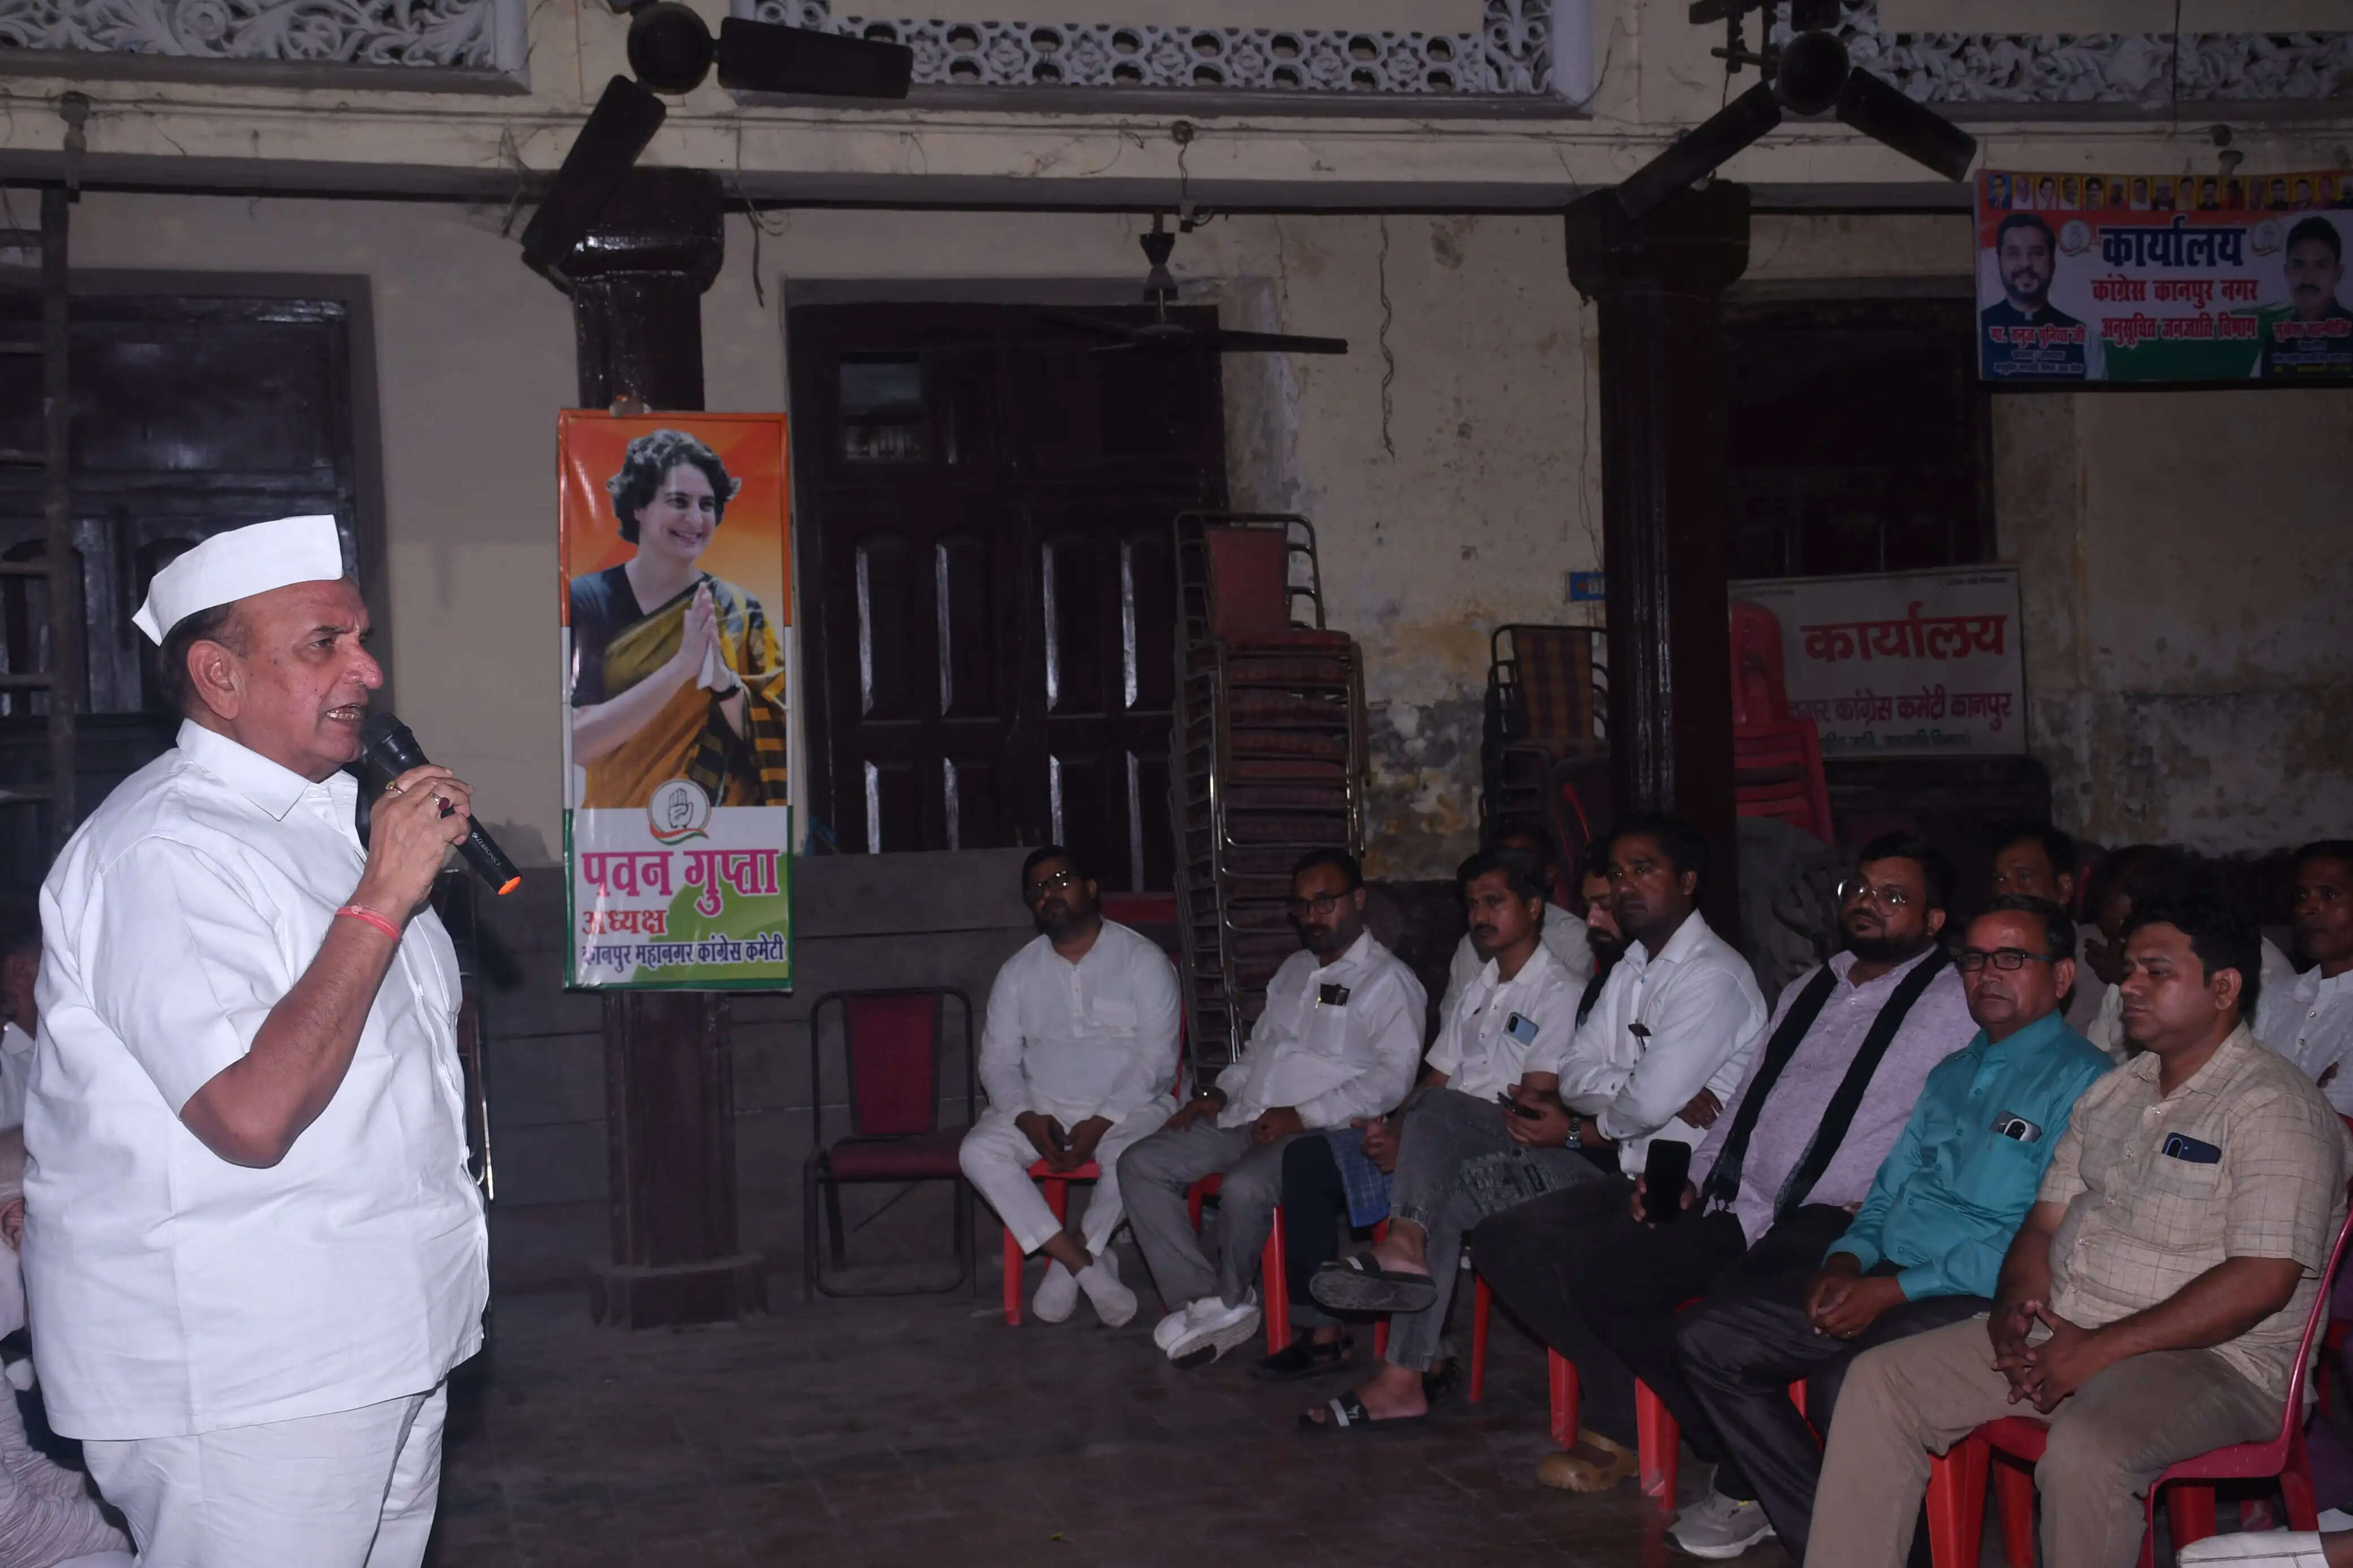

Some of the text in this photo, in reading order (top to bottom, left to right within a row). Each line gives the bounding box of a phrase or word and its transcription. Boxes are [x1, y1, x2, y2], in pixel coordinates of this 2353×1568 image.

[2099, 215, 2246, 267] कार्यालय
[2091, 274, 2259, 309] कांग्रेस कानपुर नगर
[2101, 313, 2156, 345] अनुसूचित
[2161, 313, 2213, 338] जनजाति
[1799, 601, 2007, 663] कार्यालय
[1833, 688, 1893, 725] कांग्रेस
[1897, 683, 1946, 720] कमेटी
[1950, 692, 2012, 731] कानपुर
[476, 838, 501, 867] ZEBRONICS
[581, 849, 780, 915] पवन गुप्ता
[582, 909, 667, 935] अध्यक्ष
[635, 944, 693, 967] महानगर
[697, 934, 743, 964] कांग्रेस
[745, 934, 785, 961] कमेटी
